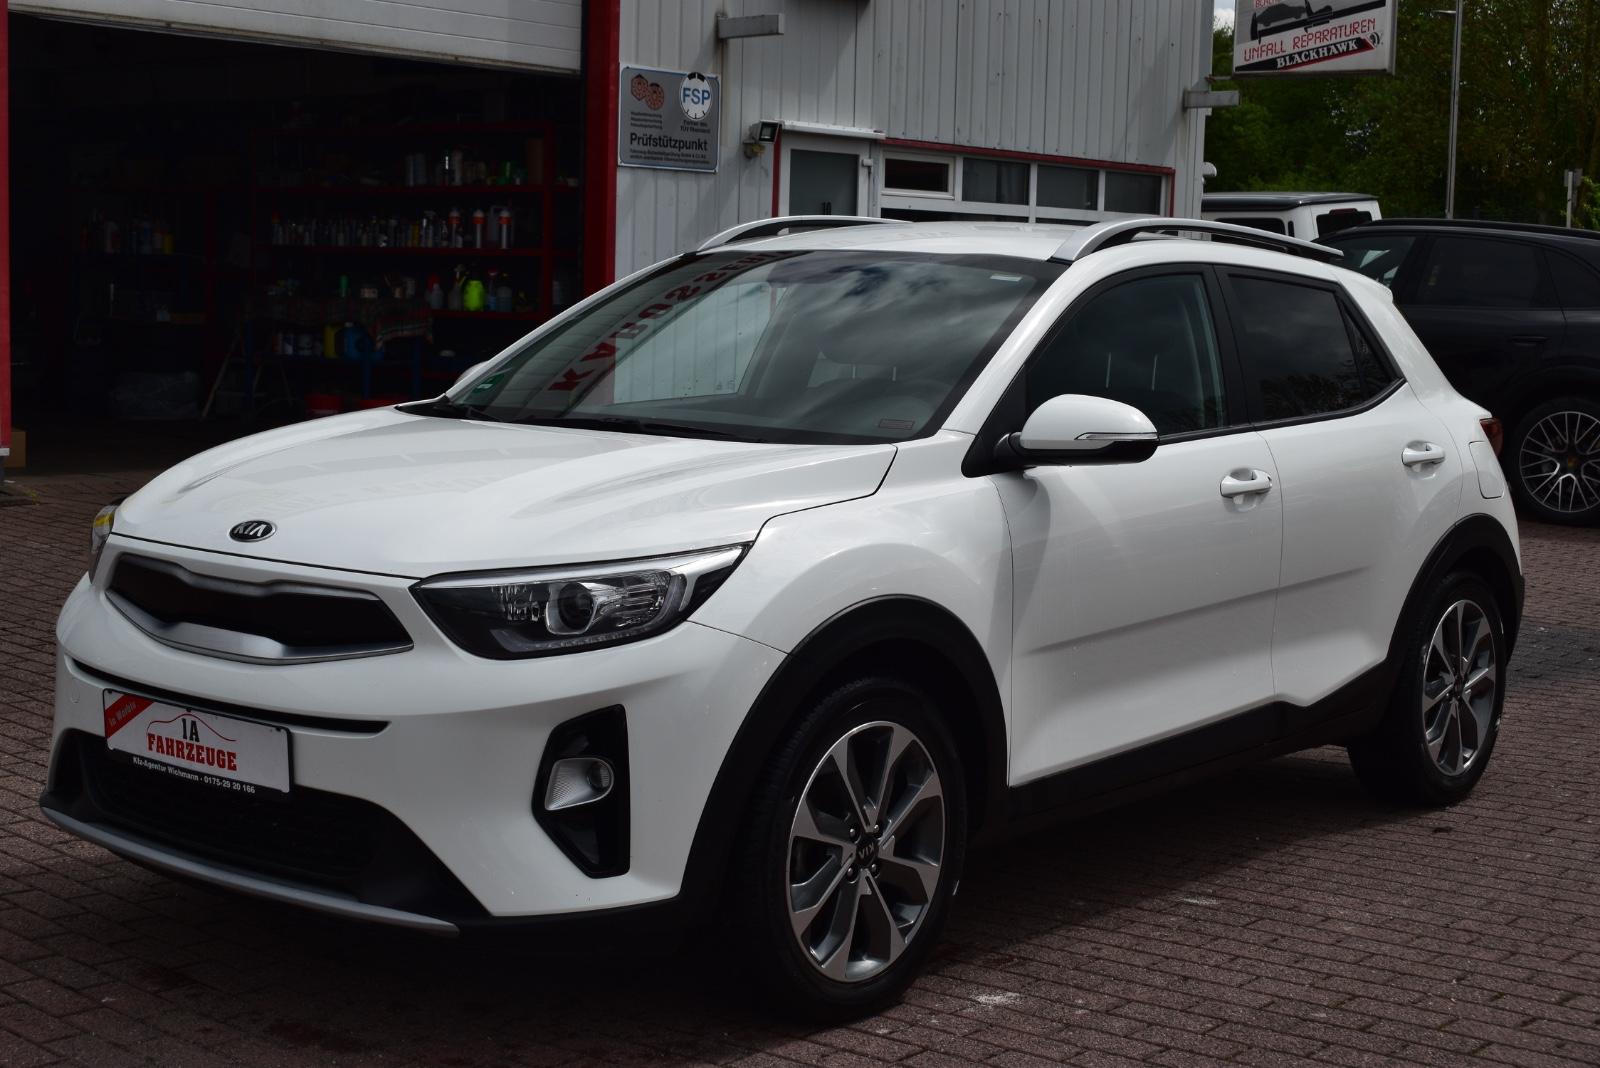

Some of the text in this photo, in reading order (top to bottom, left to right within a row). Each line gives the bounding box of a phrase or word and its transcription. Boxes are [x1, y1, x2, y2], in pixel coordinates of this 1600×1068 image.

[1244, 18, 1376, 62] UNFALL REPARATUREN
[1276, 40, 1358, 69] BLACKHAWK
[682, 88, 711, 105] FSP
[630, 132, 708, 151] Prüfstützpunkt
[233, 522, 268, 538] KIA
[147, 733, 237, 771] FAHRZEUGE
[132, 756, 166, 771] Kfz-Agentur
[168, 767, 199, 781] Wichmann
